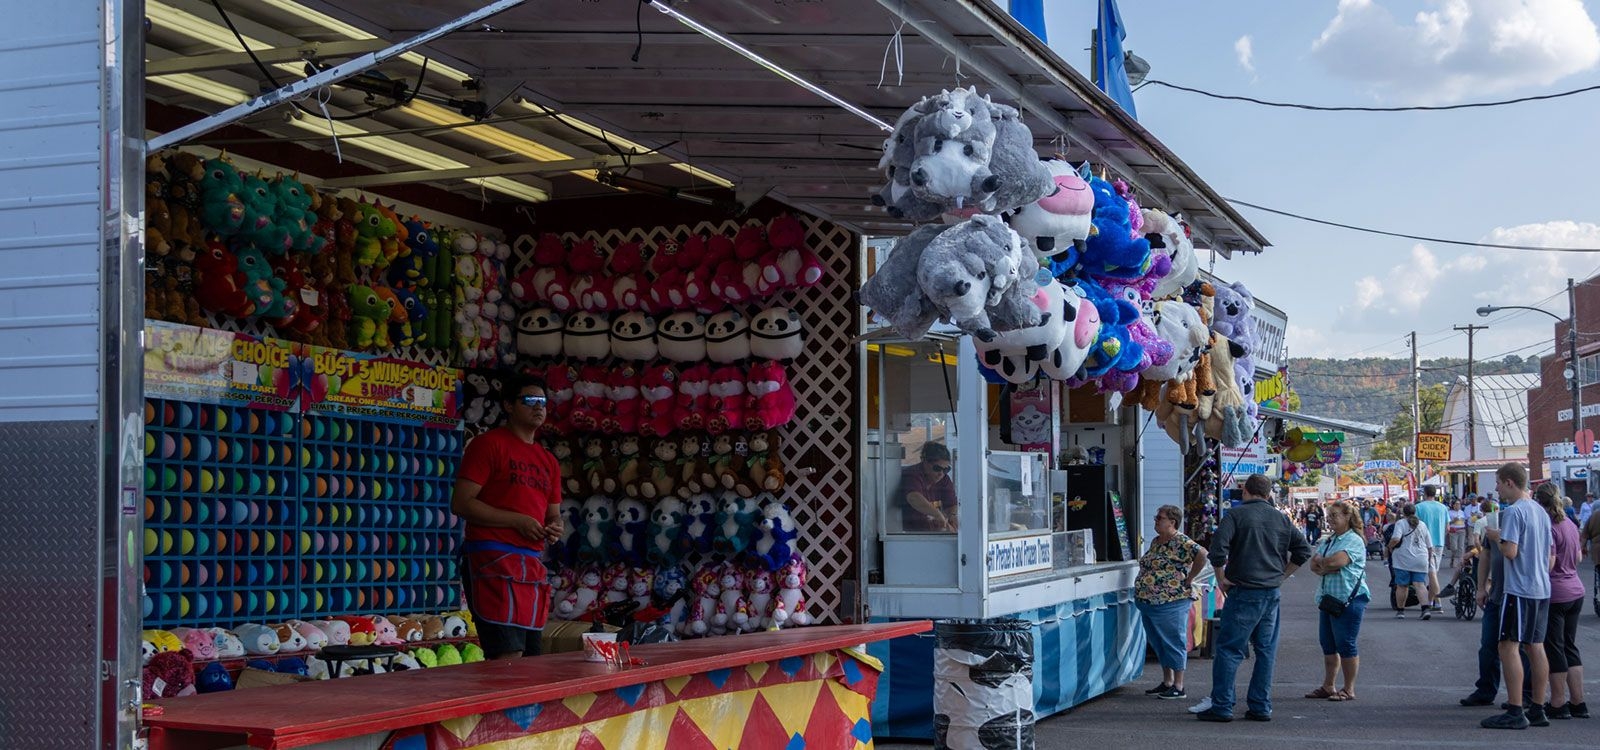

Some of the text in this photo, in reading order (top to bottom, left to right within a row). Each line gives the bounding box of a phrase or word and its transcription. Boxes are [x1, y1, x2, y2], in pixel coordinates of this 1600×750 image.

[160, 328, 173, 353] 3
[231, 339, 289, 368] CHOICE
[314, 353, 456, 391] BUST 3 WINS CHOICE
[161, 374, 182, 382] ONE
[230, 382, 249, 390] PER
[251, 384, 277, 394] DART
[361, 382, 369, 395] 3
[370, 383, 402, 397] DARTS
[210, 391, 252, 401] PERSON
[254, 395, 273, 403] PER
[275, 398, 294, 407] DAY
[327, 395, 358, 404] BREAK
[409, 403, 424, 411] PER
[426, 406, 447, 415] DART
[310, 402, 335, 411] LIMIT
[337, 404, 345, 412] 2
[346, 407, 377, 416] PRIZES
[379, 409, 394, 418] PER
[396, 411, 427, 421] PERSON
[428, 415, 442, 423] PER
[1419, 435, 1449, 444] BENTON
[1015, 540, 1023, 568] and
[1024, 540, 1037, 567] Frozen
